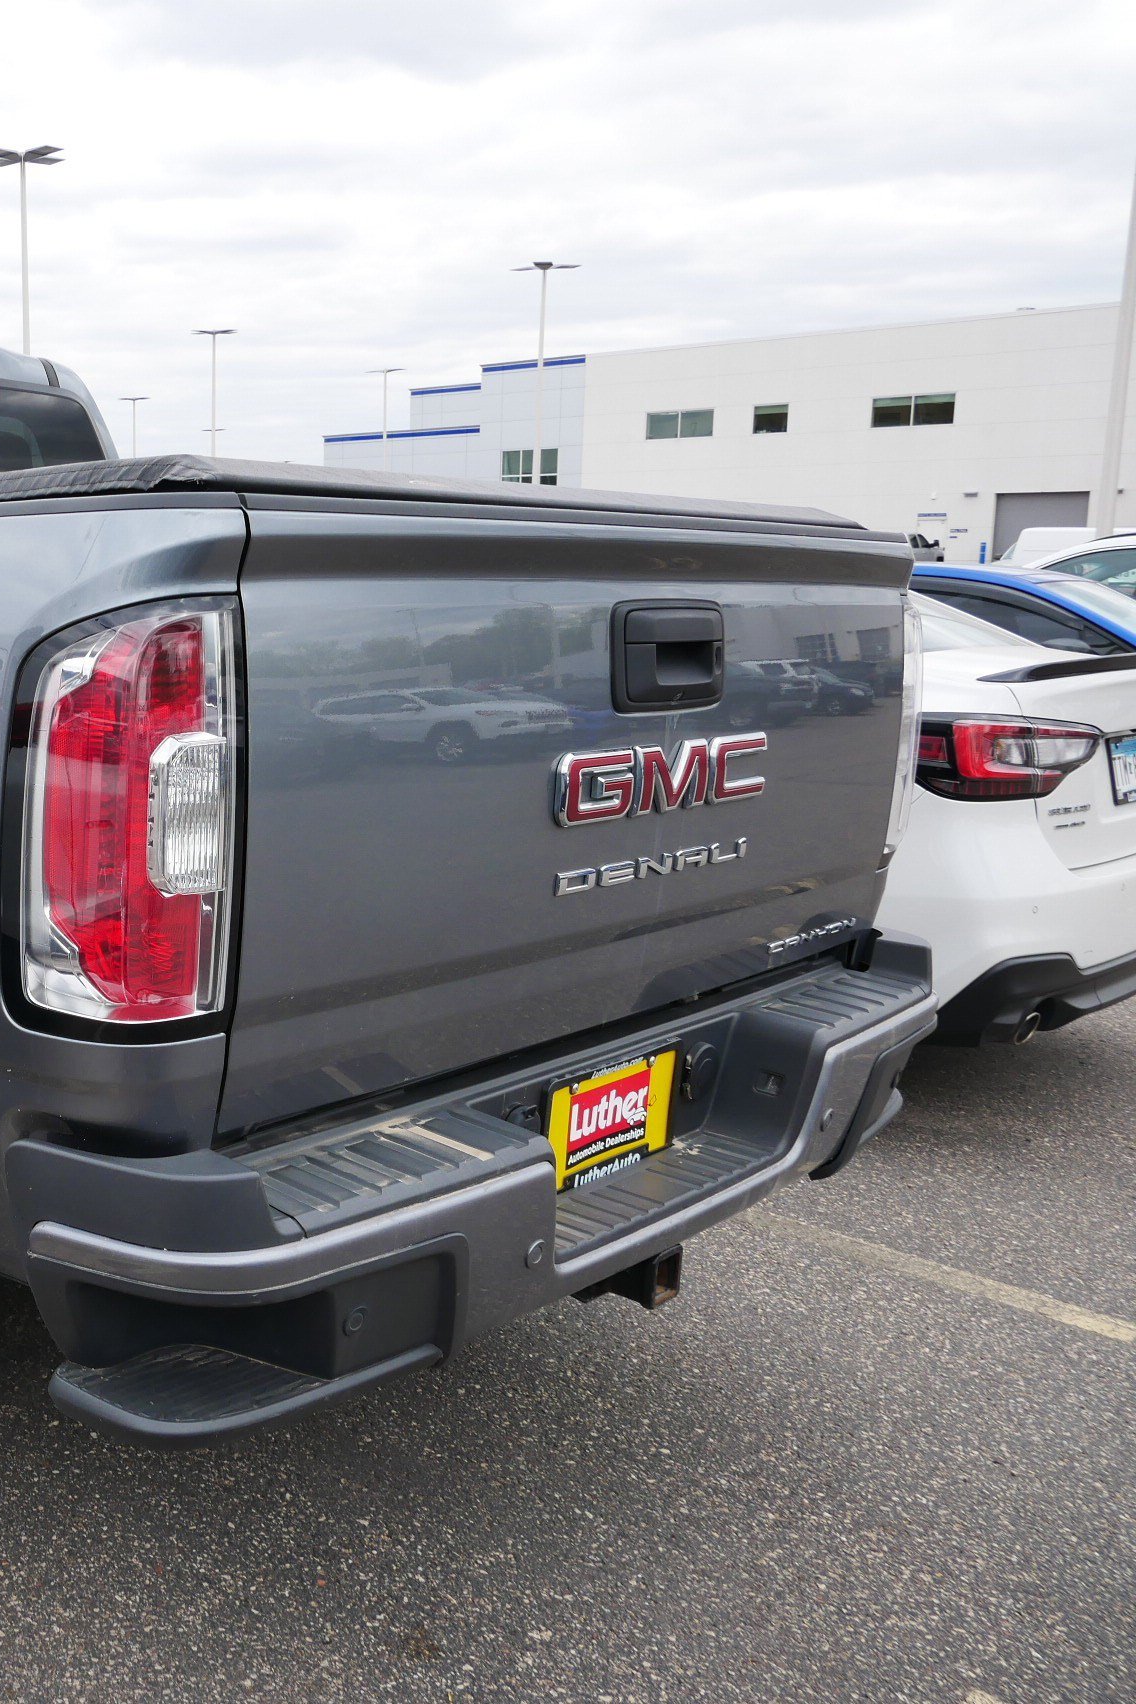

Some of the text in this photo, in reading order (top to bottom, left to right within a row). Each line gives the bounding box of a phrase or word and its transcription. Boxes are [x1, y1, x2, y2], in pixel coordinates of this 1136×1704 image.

[552, 732, 767, 828] GMC
[554, 837, 747, 896] DENALI
[767, 917, 857, 954] CANYON
[569, 1085, 650, 1143] Luther
[567, 1127, 645, 1166] Automobile Dealerships
